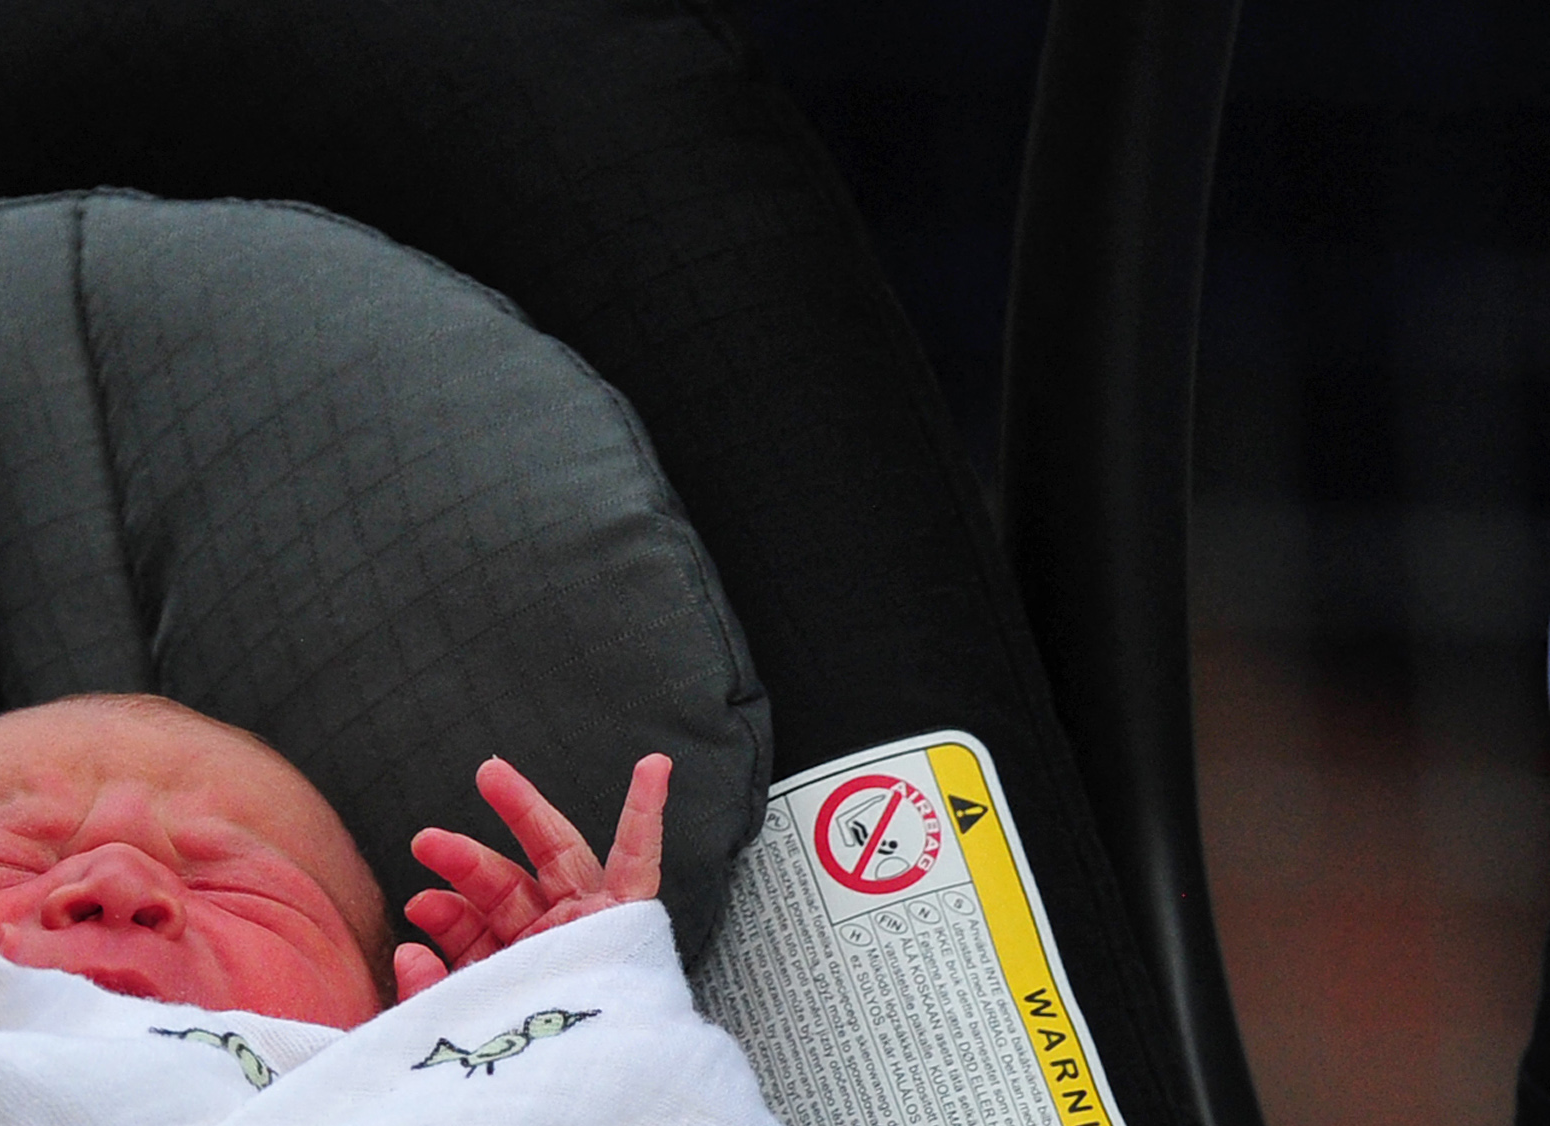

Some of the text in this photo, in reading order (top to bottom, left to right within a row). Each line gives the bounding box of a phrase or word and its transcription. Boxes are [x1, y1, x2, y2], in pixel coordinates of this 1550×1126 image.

[764, 810, 784, 830] PL
[889, 780, 941, 870] AIRBAG
[782, 932, 801, 958] tuto
[876, 911, 901, 936] FIN
[751, 942, 770, 968] toto
[761, 968, 787, 1017] dozadu
[780, 833, 799, 859] NIE
[852, 1033, 894, 1118] skierowanego
[789, 957, 812, 989] proti
[969, 969, 989, 998] med
[983, 964, 1004, 996] INTE
[994, 996, 1019, 1035] denna
[908, 963, 942, 1030] KOSKAAN
[933, 1030, 956, 1067] aseta
[933, 925, 953, 957] IKKE
[945, 957, 964, 986] bruk
[956, 987, 976, 1019] dette
[992, 1087, 1009, 1115] som
[772, 1039, 794, 1080] mohlo
[807, 1044, 826, 1074] smrt
[818, 1073, 839, 1107] nebo
[935, 981, 954, 1006] kan
[957, 1040, 979, 1073] DØD
[970, 1074, 996, 1119] ELLER
[888, 1060, 923, 1125] HALÁLOS
